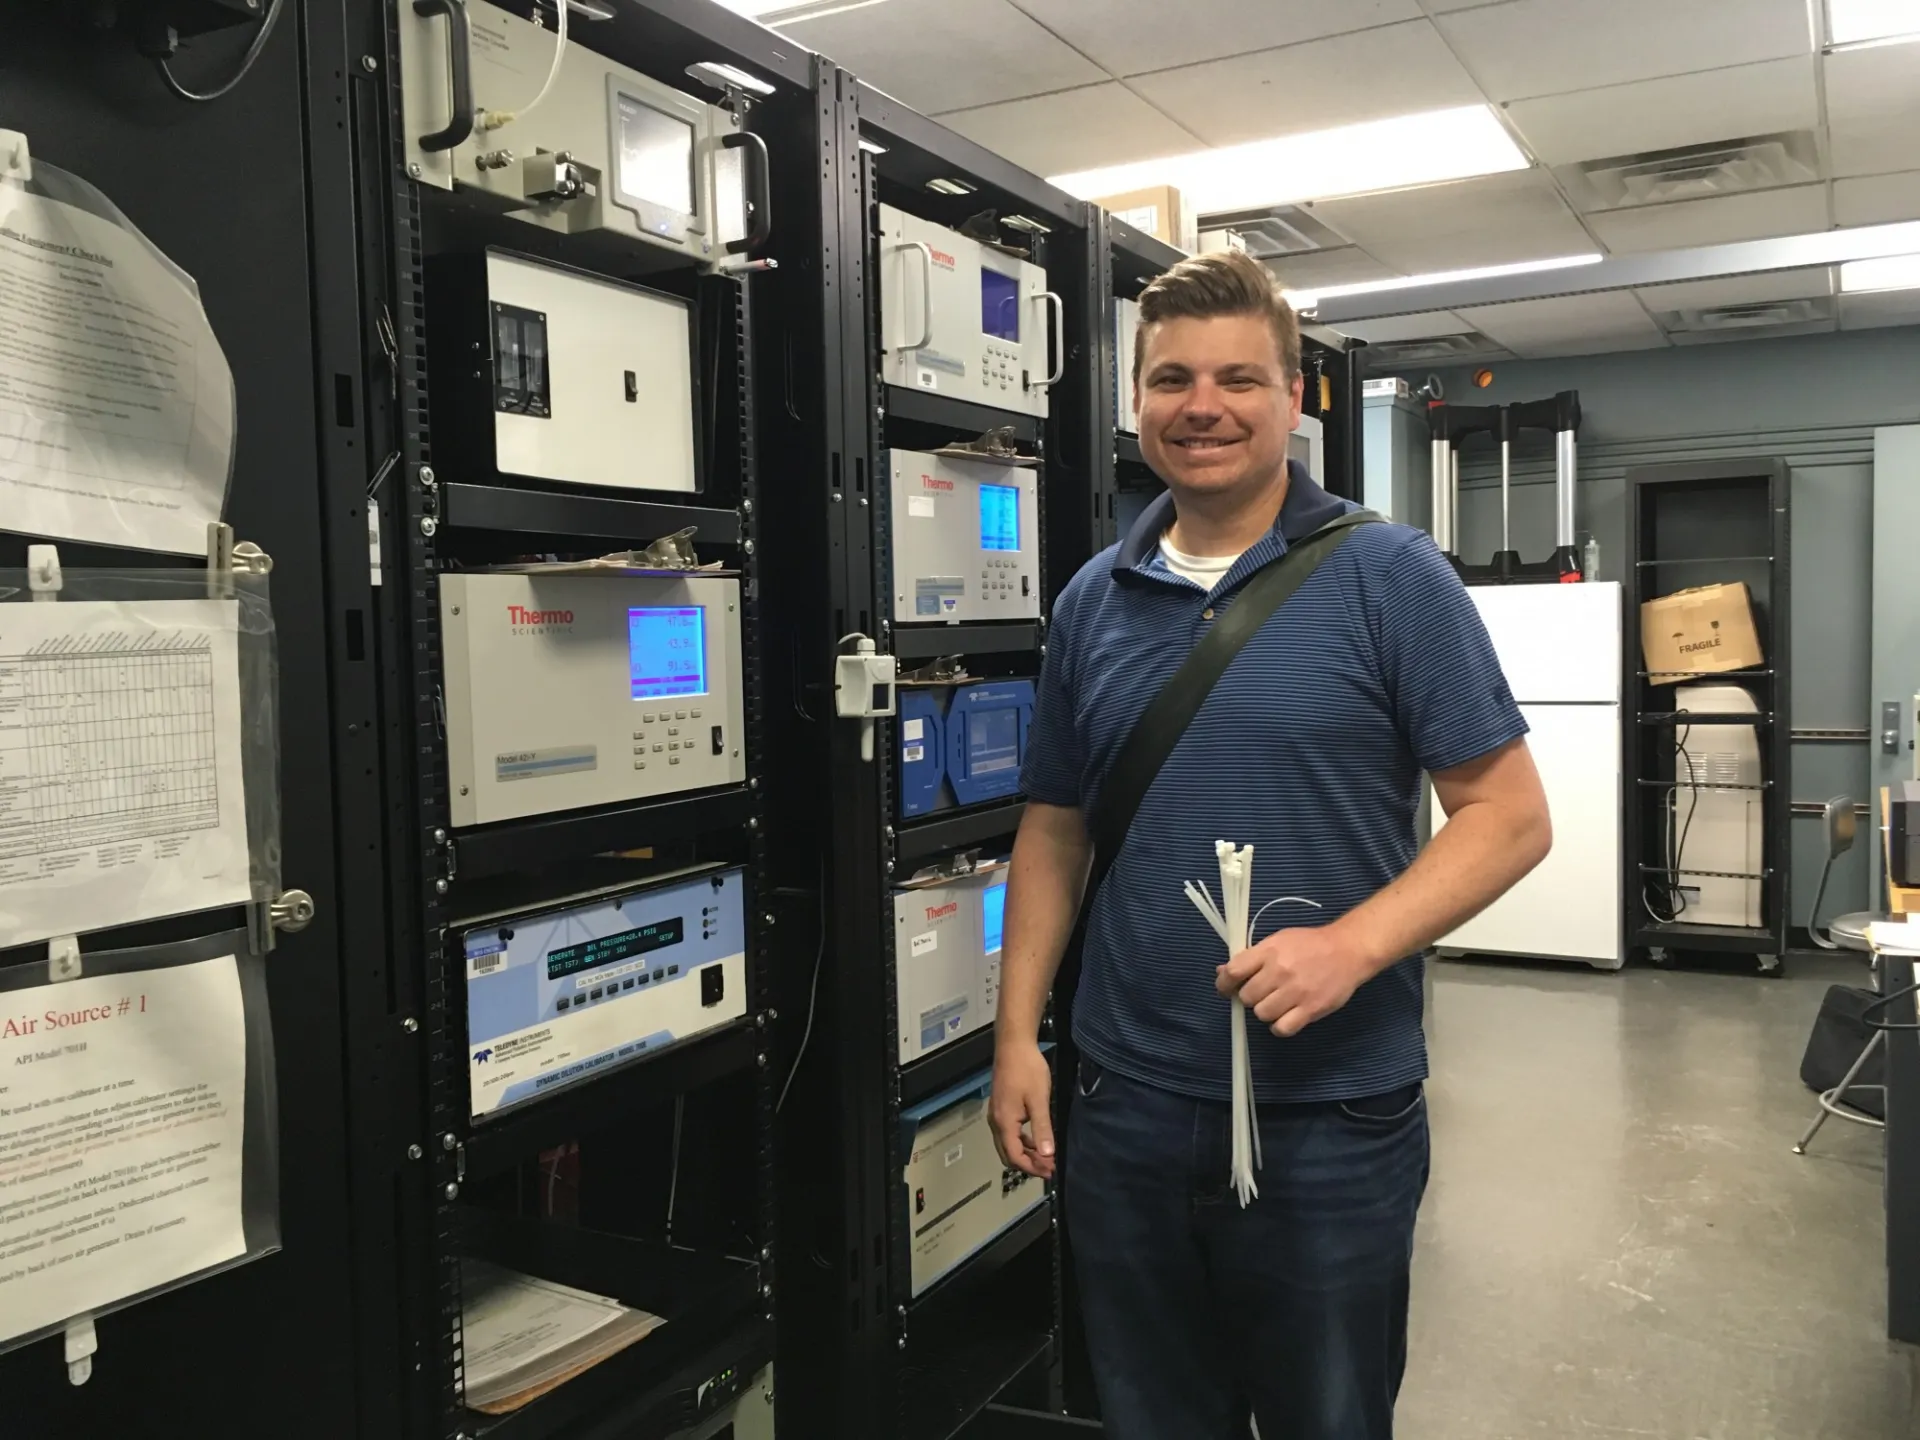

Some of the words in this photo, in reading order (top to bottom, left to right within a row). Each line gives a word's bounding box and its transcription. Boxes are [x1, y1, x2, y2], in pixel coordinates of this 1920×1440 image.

[72, 246, 113, 268] Checklist
[921, 474, 954, 491] Thermo
[507, 606, 574, 624] Thermo
[511, 626, 574, 636] SCIENTIFIC
[1679, 638, 1721, 654] FRAGILE
[497, 754, 518, 764] Model
[925, 902, 958, 920] Thermo
[658, 932, 674, 942] SETUP
[2, 1016, 38, 1039] Air
[45, 1004, 112, 1030] Source
[117, 996, 130, 1016] #
[140, 994, 146, 1012] 1
[494, 1038, 518, 1052] TELEDYNE
[520, 1028, 551, 1044] INSTRUMENTS
[15, 1055, 33, 1066] API
[36, 1048, 62, 1061] Model
[536, 1072, 560, 1088] DYNAMIC
[560, 1064, 584, 1079] DILUTION
[584, 1052, 614, 1070] CALIBRATOR
[1, 1108, 10, 1116] be
[13, 1102, 32, 1114] used
[34, 1098, 52, 1108] with
[66, 1086, 102, 1100] calibrator
[20, 1124, 46, 1136] output
[57, 1112, 92, 1126] calibrator
[93, 1107, 108, 1116] then
[110, 1102, 131, 1112] adjust
[132, 1093, 166, 1106] calibrator
[168, 1086, 196, 1098] settings
[10, 1138, 42, 1150] dilution
[43, 1128, 73, 1142] pressure
[74, 1120, 102, 1132] reading
[114, 1108, 148, 1122] calibrator
[150, 1102, 172, 1112] screen
[182, 1096, 196, 1104] that
[28, 1145, 52, 1156] adjust
[86, 1130, 104, 1140] front
[104, 1124, 124, 1138] panel
[162, 1107, 196, 1122] generator
[206, 1101, 222, 1110] they
[8, 1176, 18, 1186] of
[18, 1168, 48, 1182] desired
[38, 1189, 62, 1200] source
[73, 1179, 87, 1190] API
[88, 1172, 112, 1185] Model
[141, 1160, 158, 1172] place
[192, 1142, 221, 1154] scrubber
[6, 1210, 25, 1224] pack
[36, 1196, 70, 1213] mounted
[82, 1188, 98, 1200] back
[100, 1184, 108, 1193] of
[108, 1179, 125, 1190] rack
[126, 1174, 148, 1186] above
[32, 1220, 64, 1238] charcoal
[65, 1213, 92, 1227] column
[119, 1193, 155, 1210] Dedicated
[156, 1182, 184, 1198] charcoal
[184, 1176, 210, 1188] column
[15, 1270, 26, 1278] by
[28, 1260, 46, 1274] back
[47, 1258, 56, 1268] of
[58, 1253, 74, 1264] zero
[75, 1249, 86, 1258] air
[124, 1230, 146, 1243] Drain
[146, 1224, 154, 1235] if
